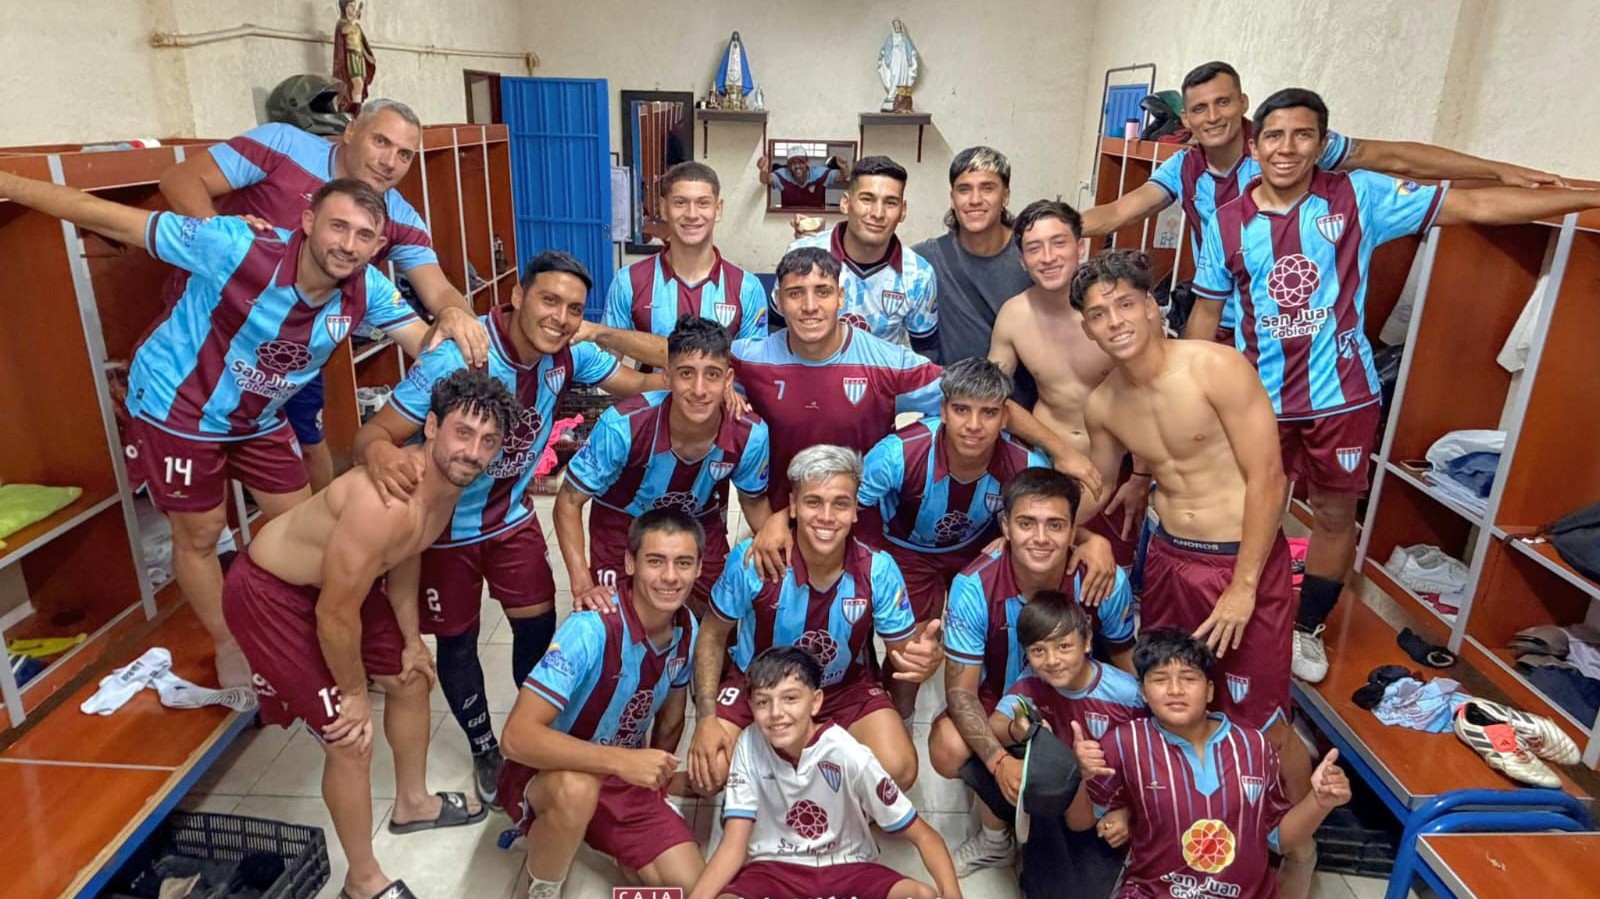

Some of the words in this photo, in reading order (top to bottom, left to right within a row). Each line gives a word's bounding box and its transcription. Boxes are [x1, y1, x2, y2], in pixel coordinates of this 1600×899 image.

[1261, 315, 1290, 328] San
[231, 360, 265, 384] San
[266, 374, 298, 392] Jua
[774, 380, 786, 400] 7
[164, 456, 192, 486] 14
[596, 569, 617, 590] 10
[426, 588, 441, 612] 2
[716, 686, 740, 706] 19
[1198, 876, 1242, 898] Juan
